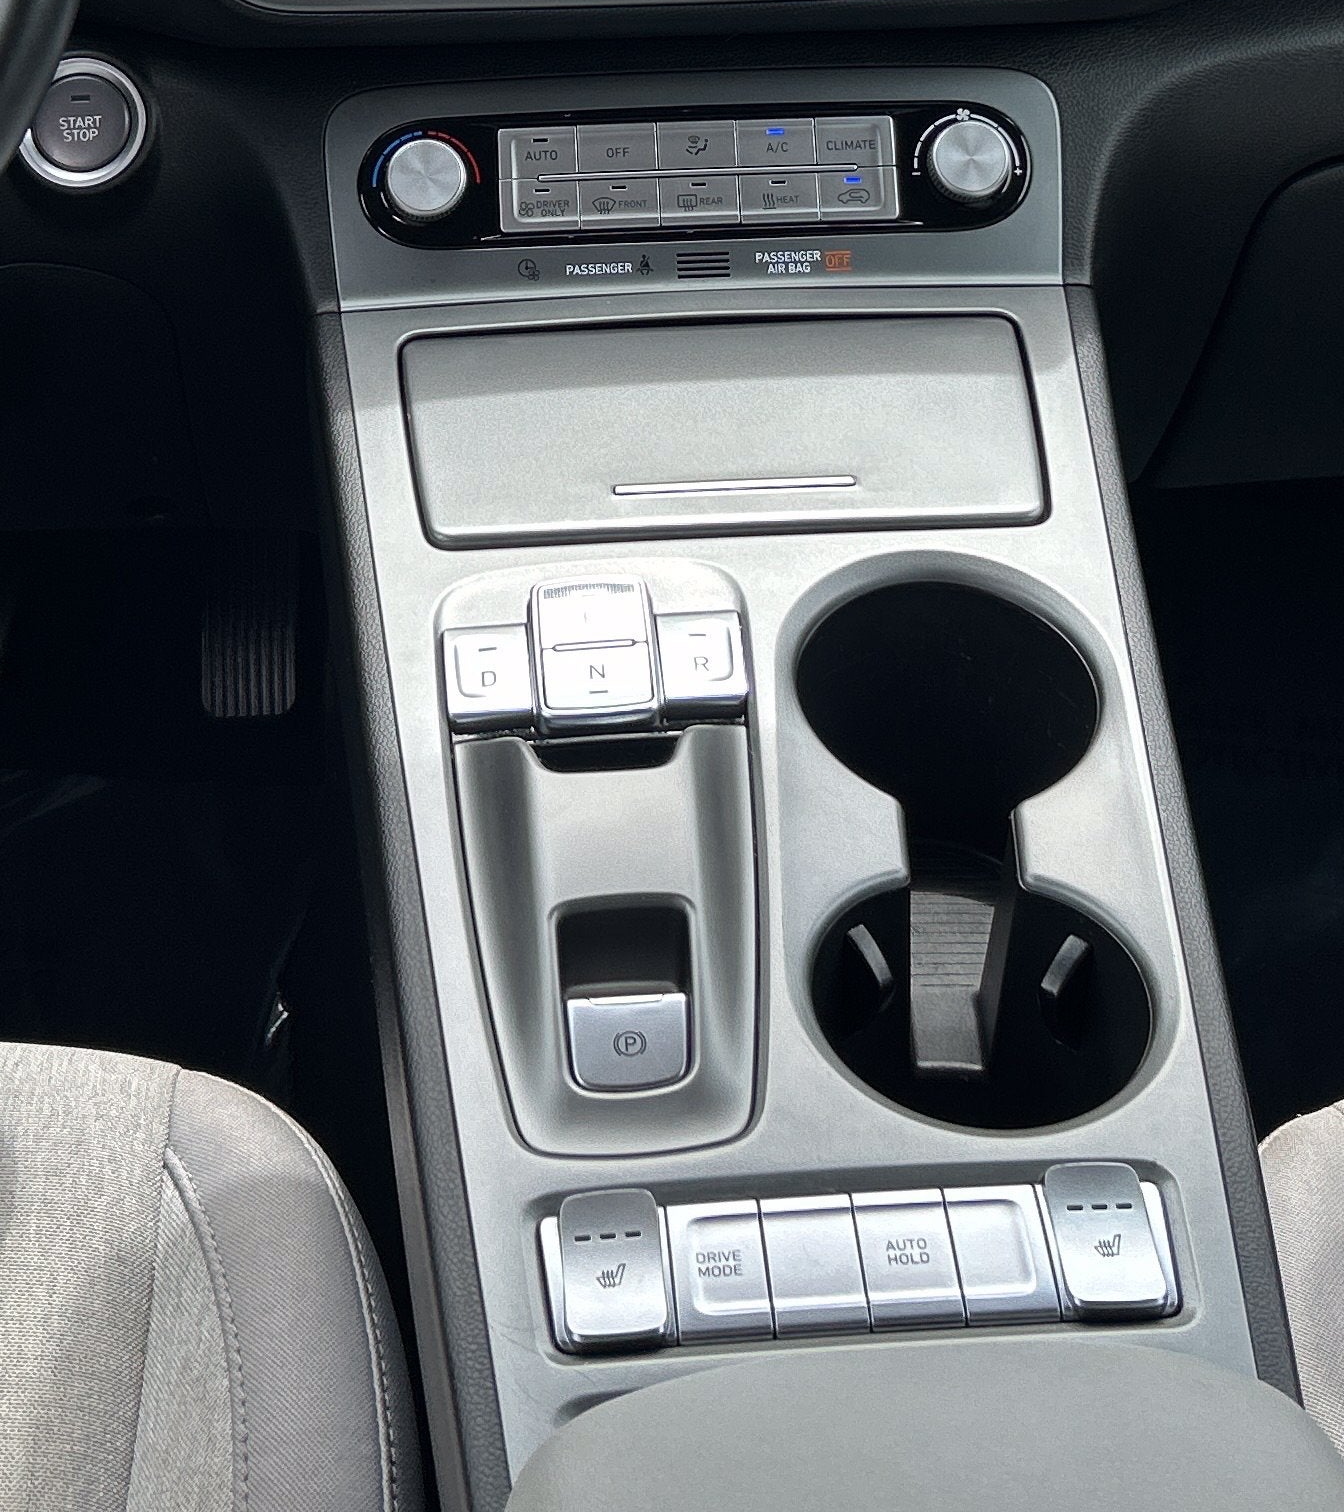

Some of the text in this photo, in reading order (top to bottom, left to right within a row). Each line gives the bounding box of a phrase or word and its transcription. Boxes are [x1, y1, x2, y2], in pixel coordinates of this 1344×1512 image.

[59, 115, 102, 129] START
[63, 128, 99, 142] STOP
[766, 141, 789, 153] A/C
[826, 139, 877, 151] CLIMATE
[524, 149, 559, 161] AUTO
[606, 147, 630, 159] OFF
[536, 199, 570, 209] DRIVER
[618, 199, 648, 209] FRONT
[699, 196, 723, 206] REAR
[776, 194, 799, 204] HEAT
[540, 207, 566, 218] ONLY
[755, 250, 851, 268] PASSENGER OFF
[566, 261, 633, 276] PASSENGER
[767, 262, 811, 274] AIR BAG
[694, 656, 710, 671] R
[481, 670, 497, 687] D
[589, 664, 605, 680] N
[885, 1238, 928, 1254] AUTO
[695, 1249, 742, 1265] DRIVE
[887, 1251, 930, 1267] HOLD
[697, 1263, 744, 1278] MODE
